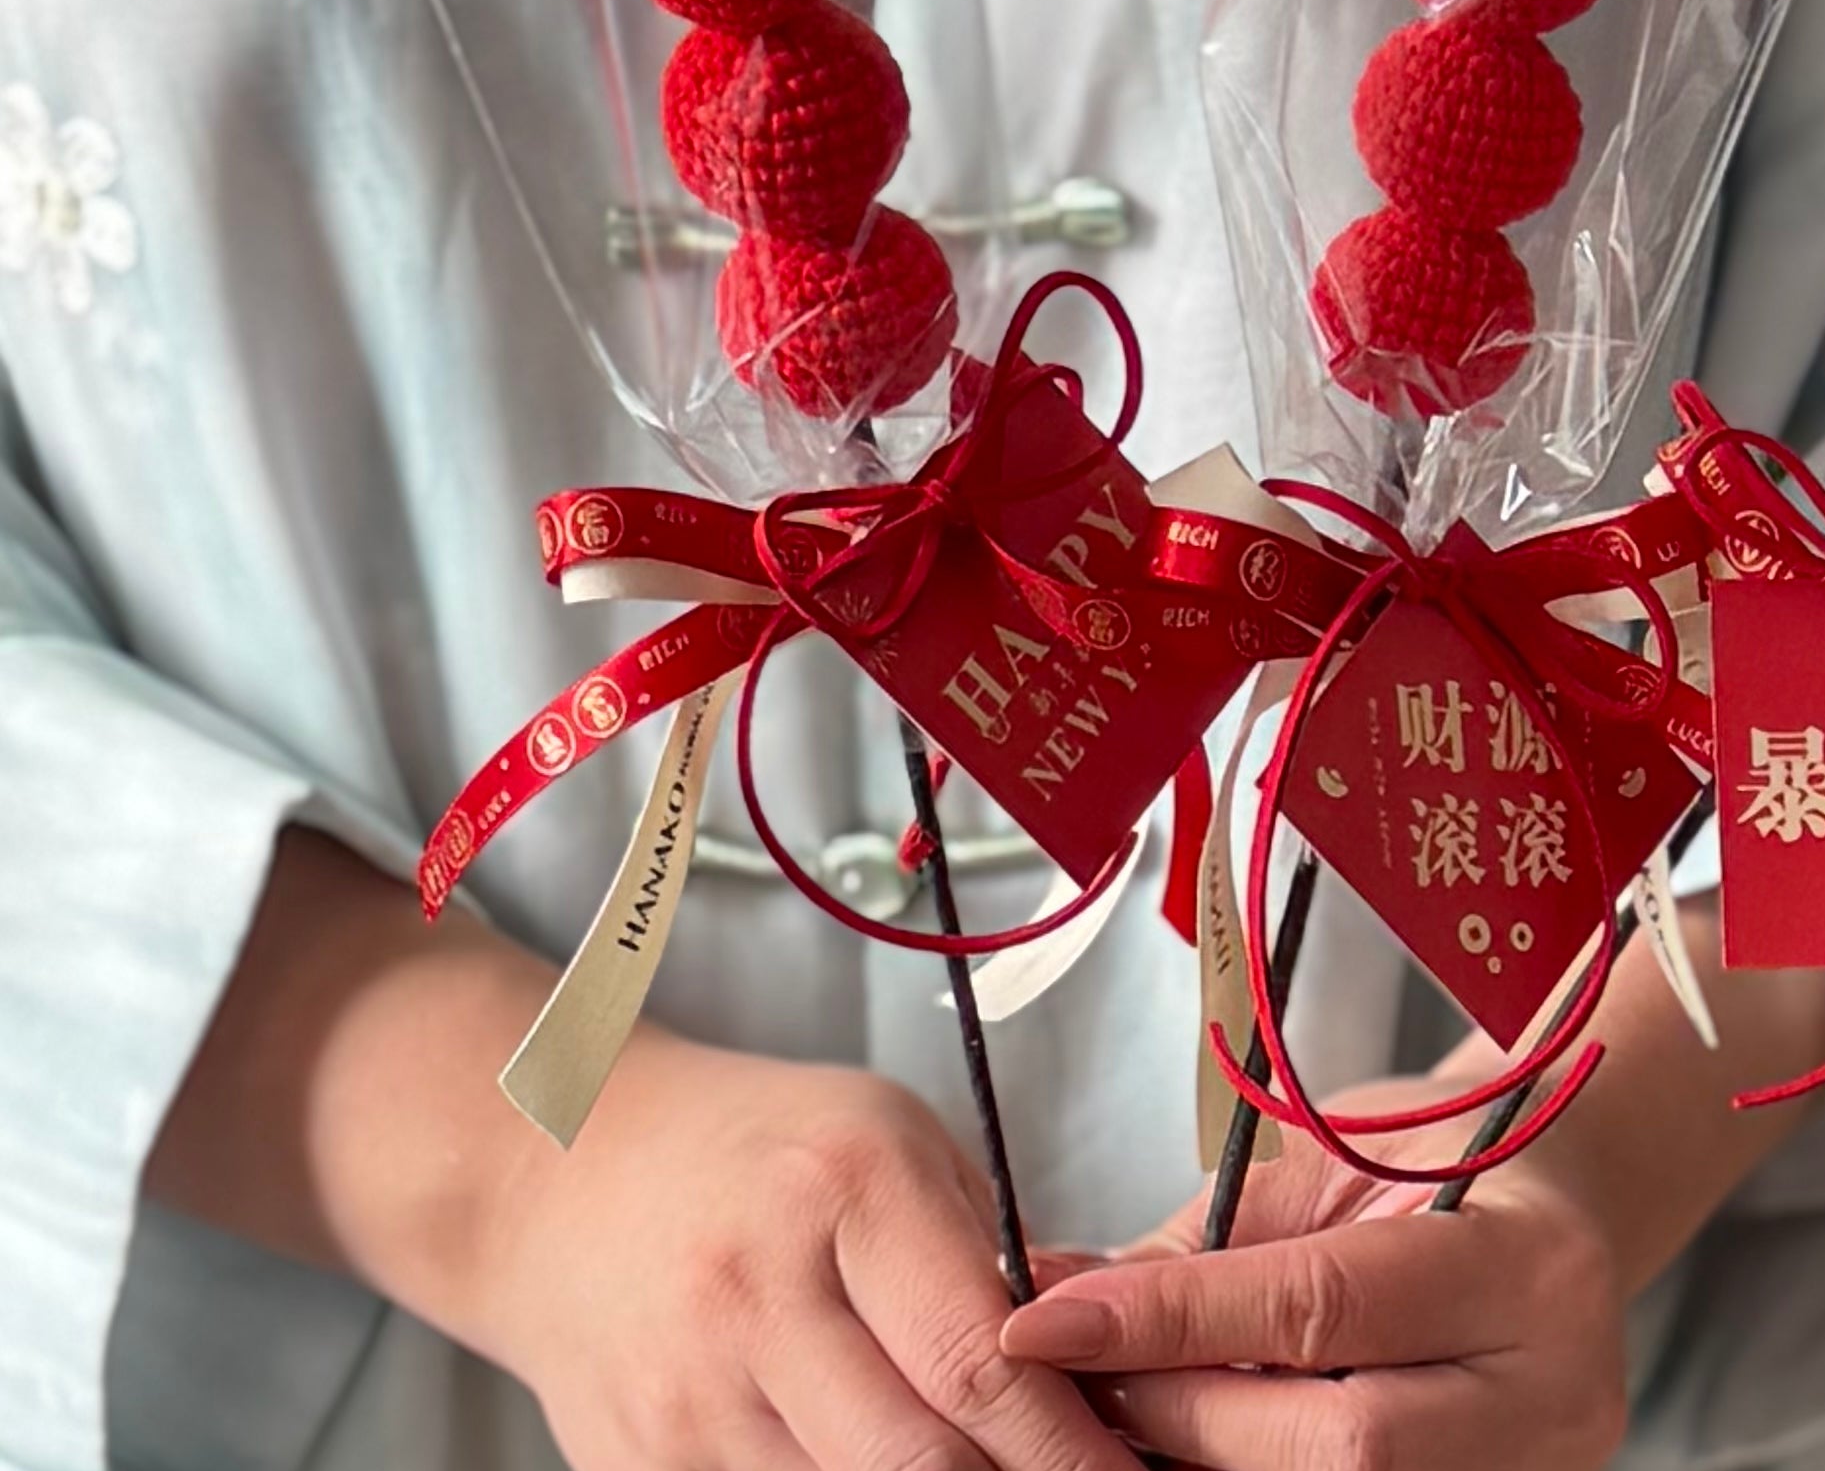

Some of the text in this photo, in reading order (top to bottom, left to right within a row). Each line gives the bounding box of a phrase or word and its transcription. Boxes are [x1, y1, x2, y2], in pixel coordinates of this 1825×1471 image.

[1167, 520, 1220, 551] RICH
[942, 483, 1137, 732] HAPY
[1162, 607, 1211, 628] RICH
[1020, 684, 1110, 802] NEW
[617, 781, 686, 953] HANAKO
[1408, 792, 1574, 889] 滚滚
